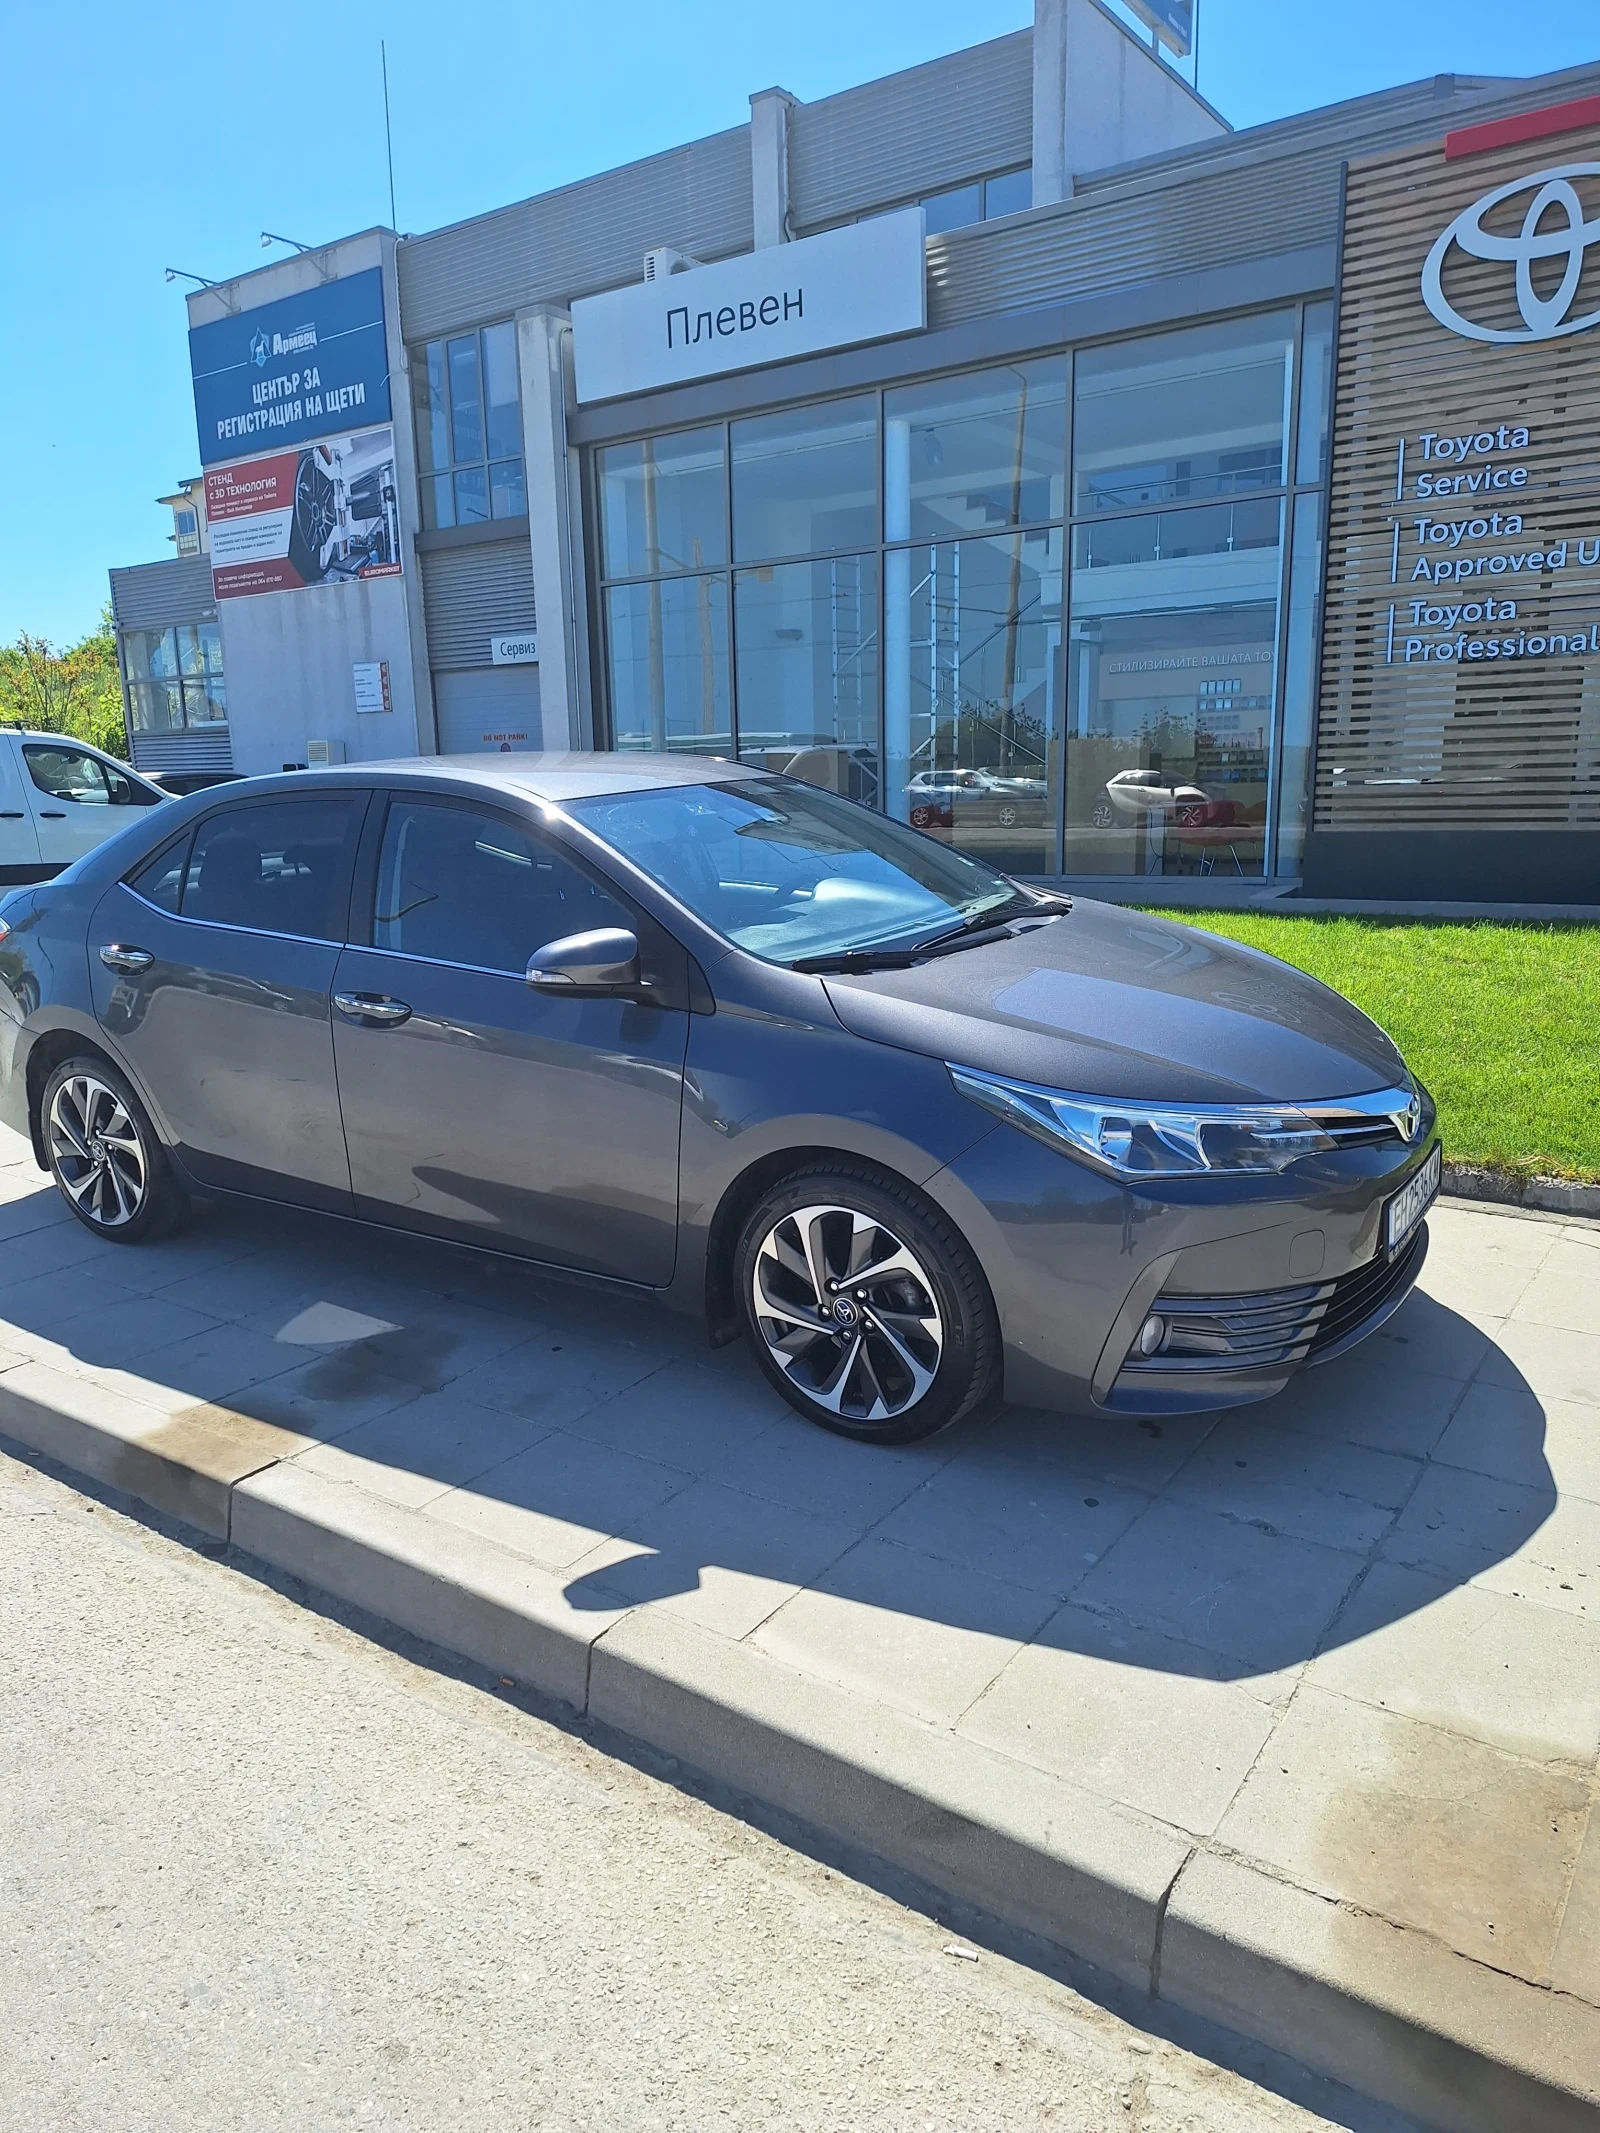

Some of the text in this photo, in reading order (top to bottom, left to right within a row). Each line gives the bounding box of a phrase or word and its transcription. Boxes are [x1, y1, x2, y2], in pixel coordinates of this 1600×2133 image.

[666, 288, 804, 349] Плевен
[273, 330, 318, 356] Армеец
[252, 366, 321, 407] ЦЕНТЪР ЗА
[216, 382, 366, 440] РЕГИСТРАЦИЯ НА ЩЕТИ
[1419, 425, 1530, 463] Toyota
[208, 472, 234, 487] СТЕНД
[214, 488, 225, 499] 3D
[225, 476, 277, 497] ТЕХНОЛОГИЯ
[1416, 464, 1528, 498] Service
[1413, 512, 1523, 548] Toyota
[364, 565, 400, 577] EUROMARKET
[1410, 540, 1568, 586] Approved
[1408, 596, 1517, 631] Toyota
[499, 641, 536, 660] Сервиз
[1405, 625, 1599, 662] Professional
[1109, 655, 1198, 673] СТИЛИЗИРАЙТЕ
[1201, 653, 1252, 666] ВАШАТА
[483, 734, 492, 742] DO
[508, 733, 528, 741] PARK!
